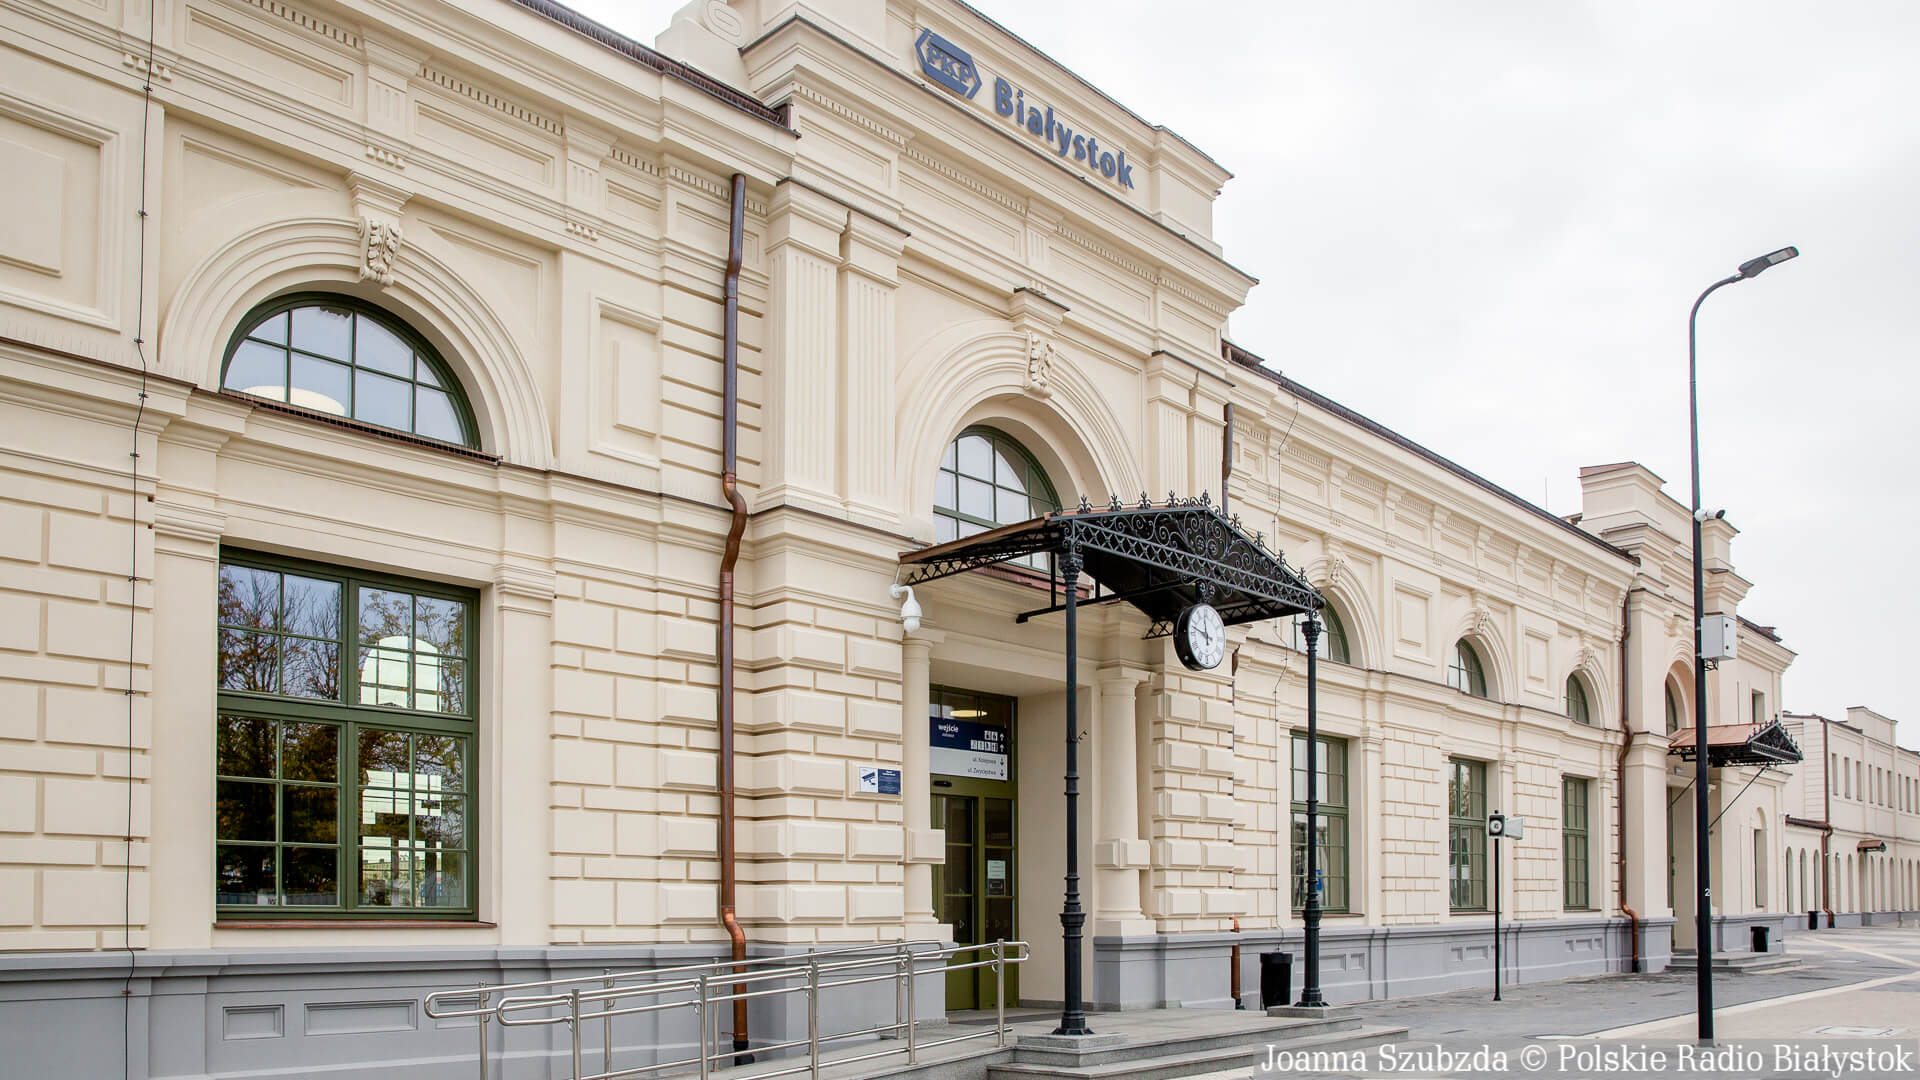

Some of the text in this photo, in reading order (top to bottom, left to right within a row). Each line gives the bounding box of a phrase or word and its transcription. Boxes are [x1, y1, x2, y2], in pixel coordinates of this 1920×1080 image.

[926, 44, 973, 83] PKP
[995, 76, 1134, 189] Białystok
[1704, 888, 1711, 896] 2
